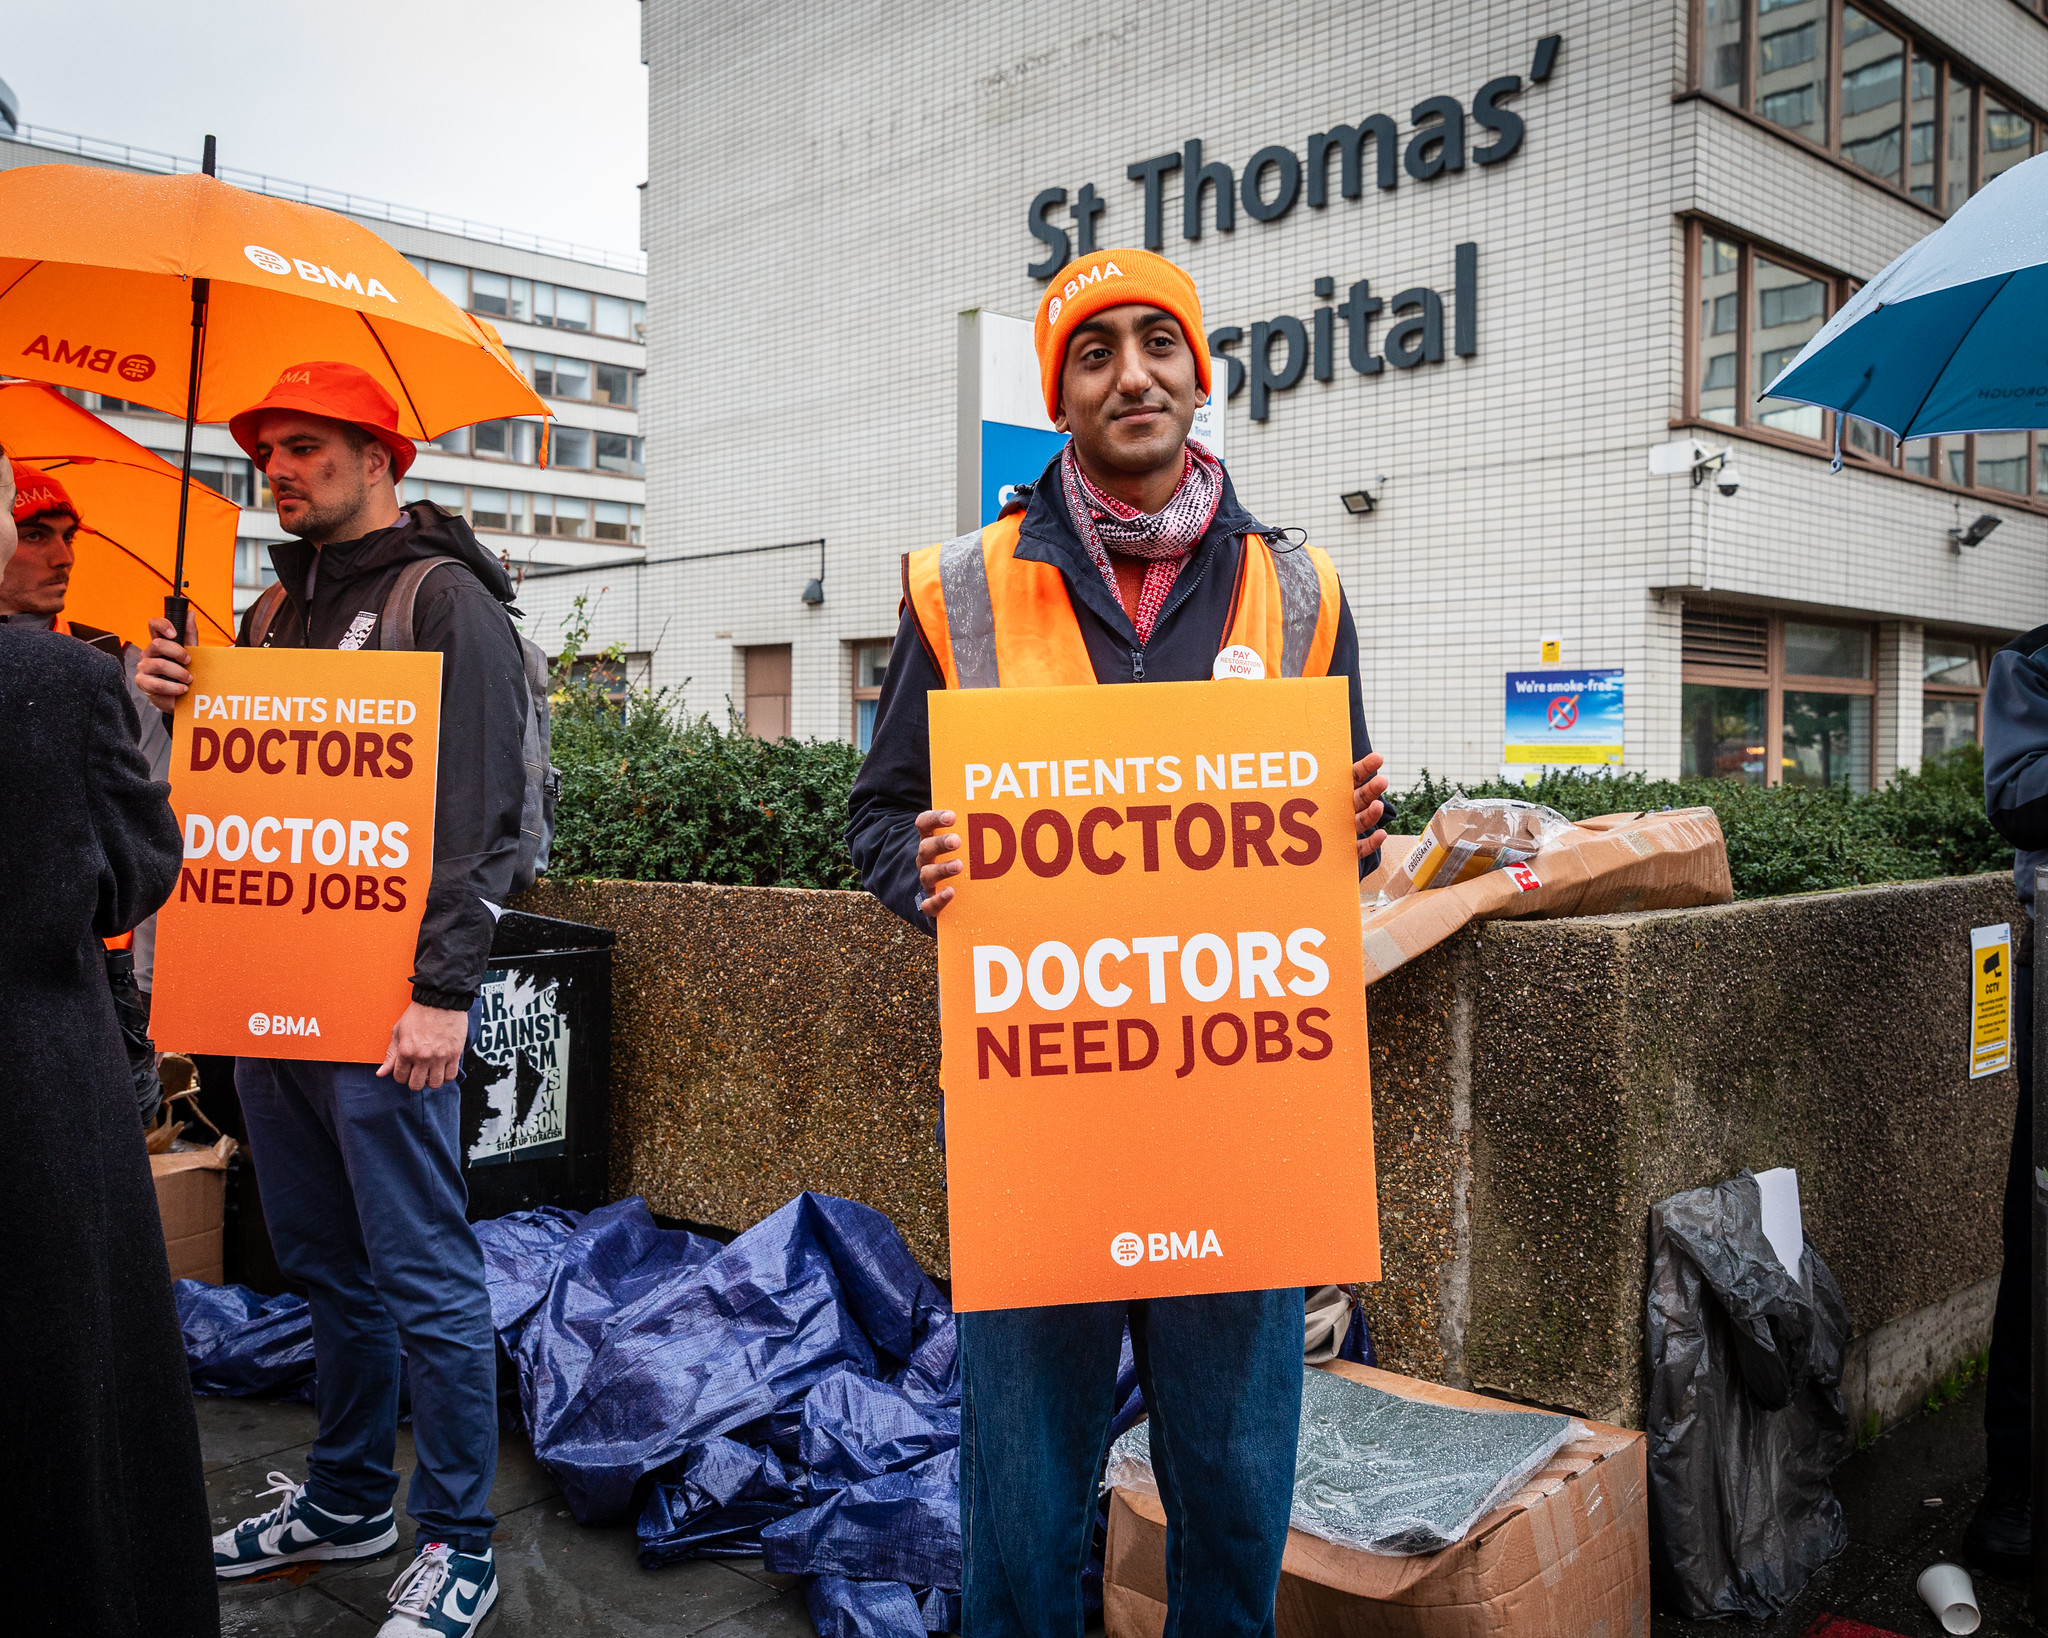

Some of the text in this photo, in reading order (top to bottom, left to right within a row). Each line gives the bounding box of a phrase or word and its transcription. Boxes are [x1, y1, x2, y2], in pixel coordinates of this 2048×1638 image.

[1027, 34, 1561, 279] St Thomas'
[292, 258, 398, 304] BMA
[1064, 261, 1124, 301] BMA
[1208, 242, 1477, 421] spital
[14, 486, 57, 508] BMA
[1220, 656, 1261, 668] RESTORATION
[1229, 664, 1252, 675] NOW
[1233, 650, 1250, 660] PAY
[1515, 679, 1546, 693] We're
[193, 695, 417, 725] PATIENTS NEED
[190, 727, 414, 779] DOCTORS
[965, 751, 1319, 800] PATIENTS NEED
[183, 814, 410, 868] DOCTORS
[967, 798, 1323, 880] DOCTORS
[179, 867, 407, 915] NEED JOBS
[973, 928, 1330, 1013] DOCTORS
[1985, 981, 2000, 994] CCTV
[272, 1015, 321, 1037] BMA
[476, 1013, 560, 1053] GAINST
[976, 1007, 1333, 1080] NEED JOBS
[518, 1137, 528, 1146] UP
[529, 1135, 538, 1144] TO
[538, 1129, 563, 1142] RACISM
[1148, 1229, 1224, 1262] BMA
